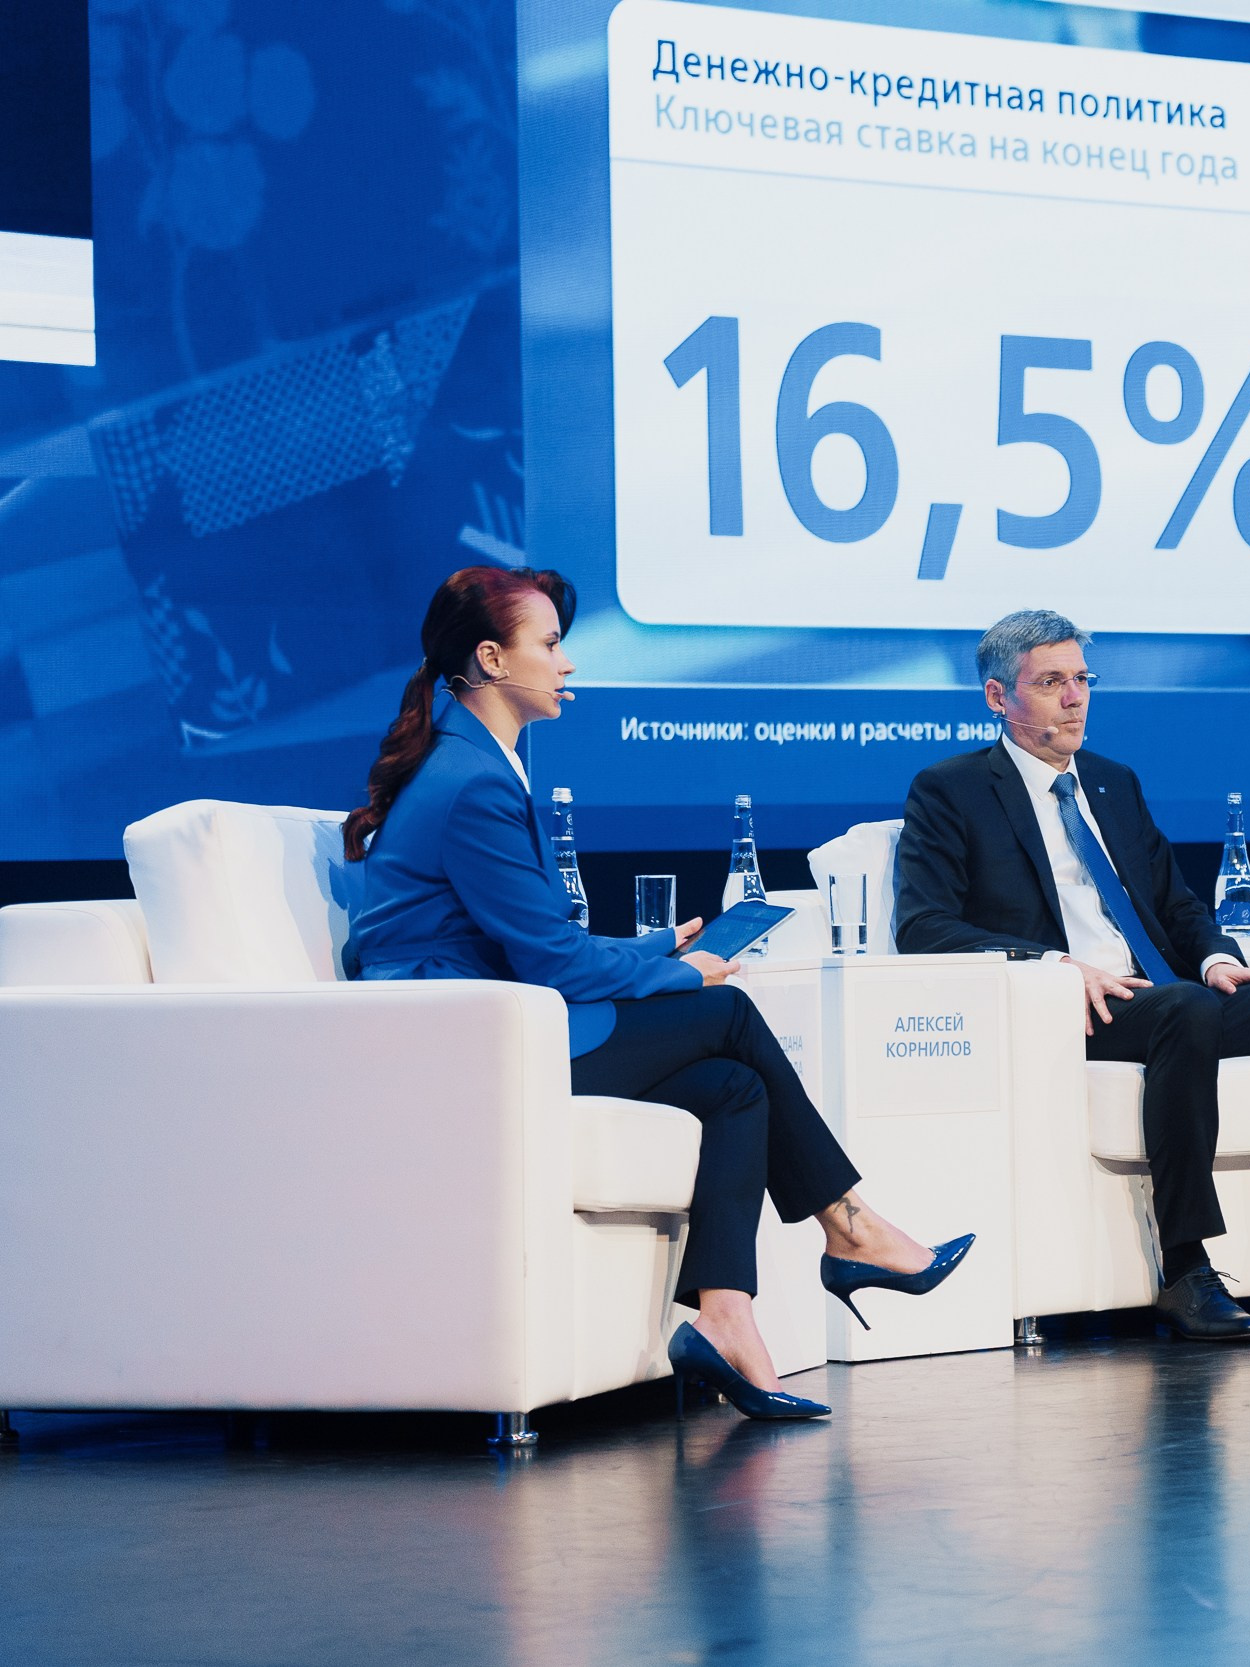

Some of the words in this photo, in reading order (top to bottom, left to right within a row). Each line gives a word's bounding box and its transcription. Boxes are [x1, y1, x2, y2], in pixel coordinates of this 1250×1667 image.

[652, 39, 1044, 113] Денежно-кредитная
[1058, 90, 1226, 129] политика
[655, 93, 844, 146] Ключевая
[856, 121, 977, 158] ставка
[989, 135, 1030, 163] на
[1042, 140, 1150, 181] конец
[1160, 150, 1238, 186] года
[621, 716, 749, 741] Источники:
[754, 721, 836, 746] оценки
[841, 722, 855, 741] и
[859, 722, 952, 747] расчеты
[894, 1012, 964, 1032] АЛЕКСЕЙ
[886, 1040, 972, 1058] КОРНИЛОВ
